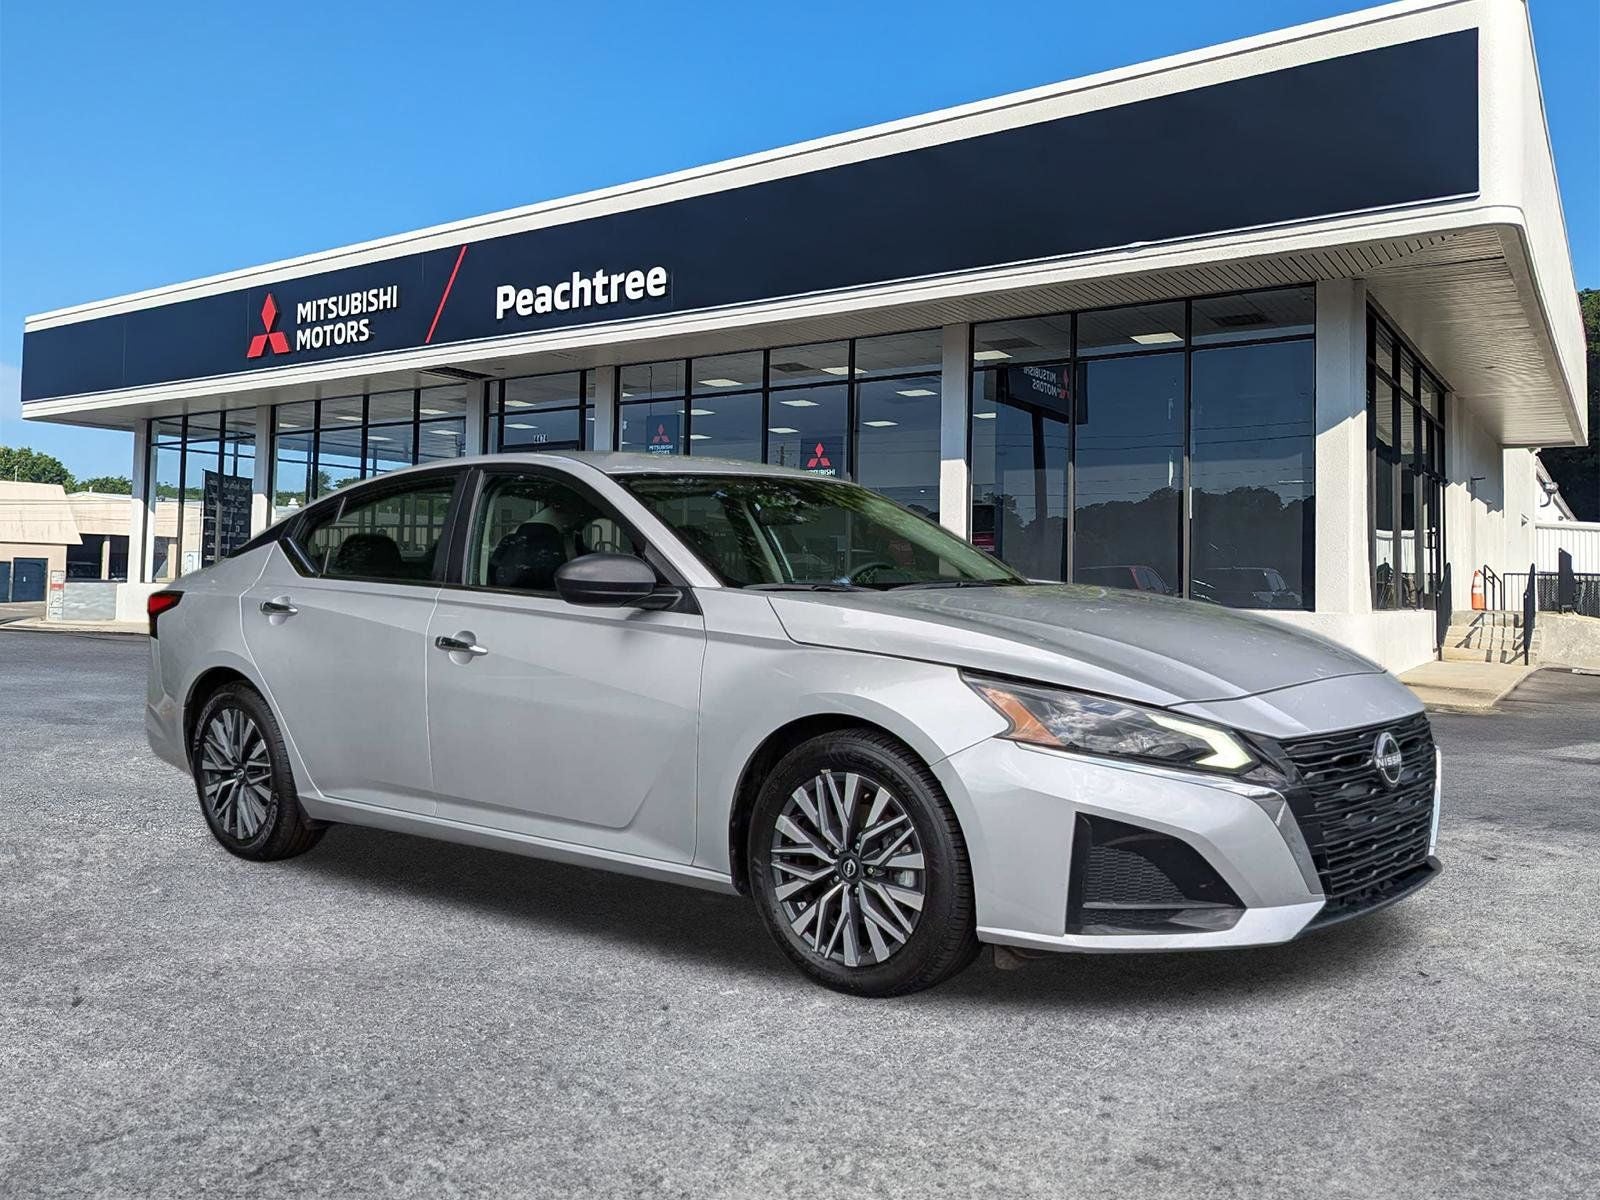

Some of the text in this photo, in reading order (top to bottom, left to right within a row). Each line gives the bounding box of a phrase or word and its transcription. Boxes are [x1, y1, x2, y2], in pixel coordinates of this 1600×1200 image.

[296, 285, 398, 324] MITSUBISHI
[496, 266, 667, 320] Peachtree
[296, 319, 370, 351] MOTORS
